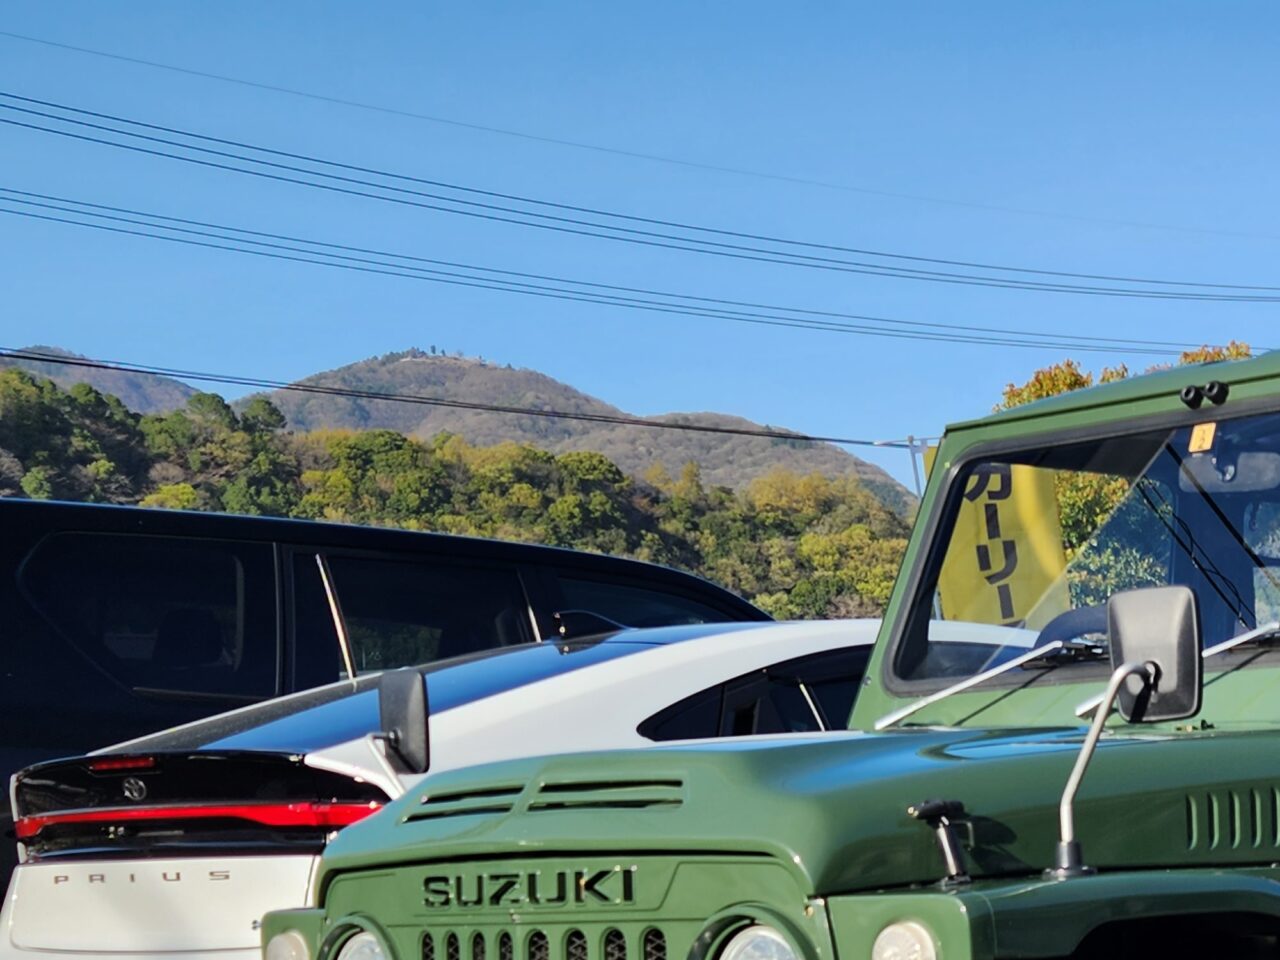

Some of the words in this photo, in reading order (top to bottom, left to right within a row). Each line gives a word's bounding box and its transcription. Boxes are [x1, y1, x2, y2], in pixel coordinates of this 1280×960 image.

[963, 464, 1020, 627] カーリー
[53, 870, 231, 885] PRIUS
[423, 867, 638, 912] SUZUKI
